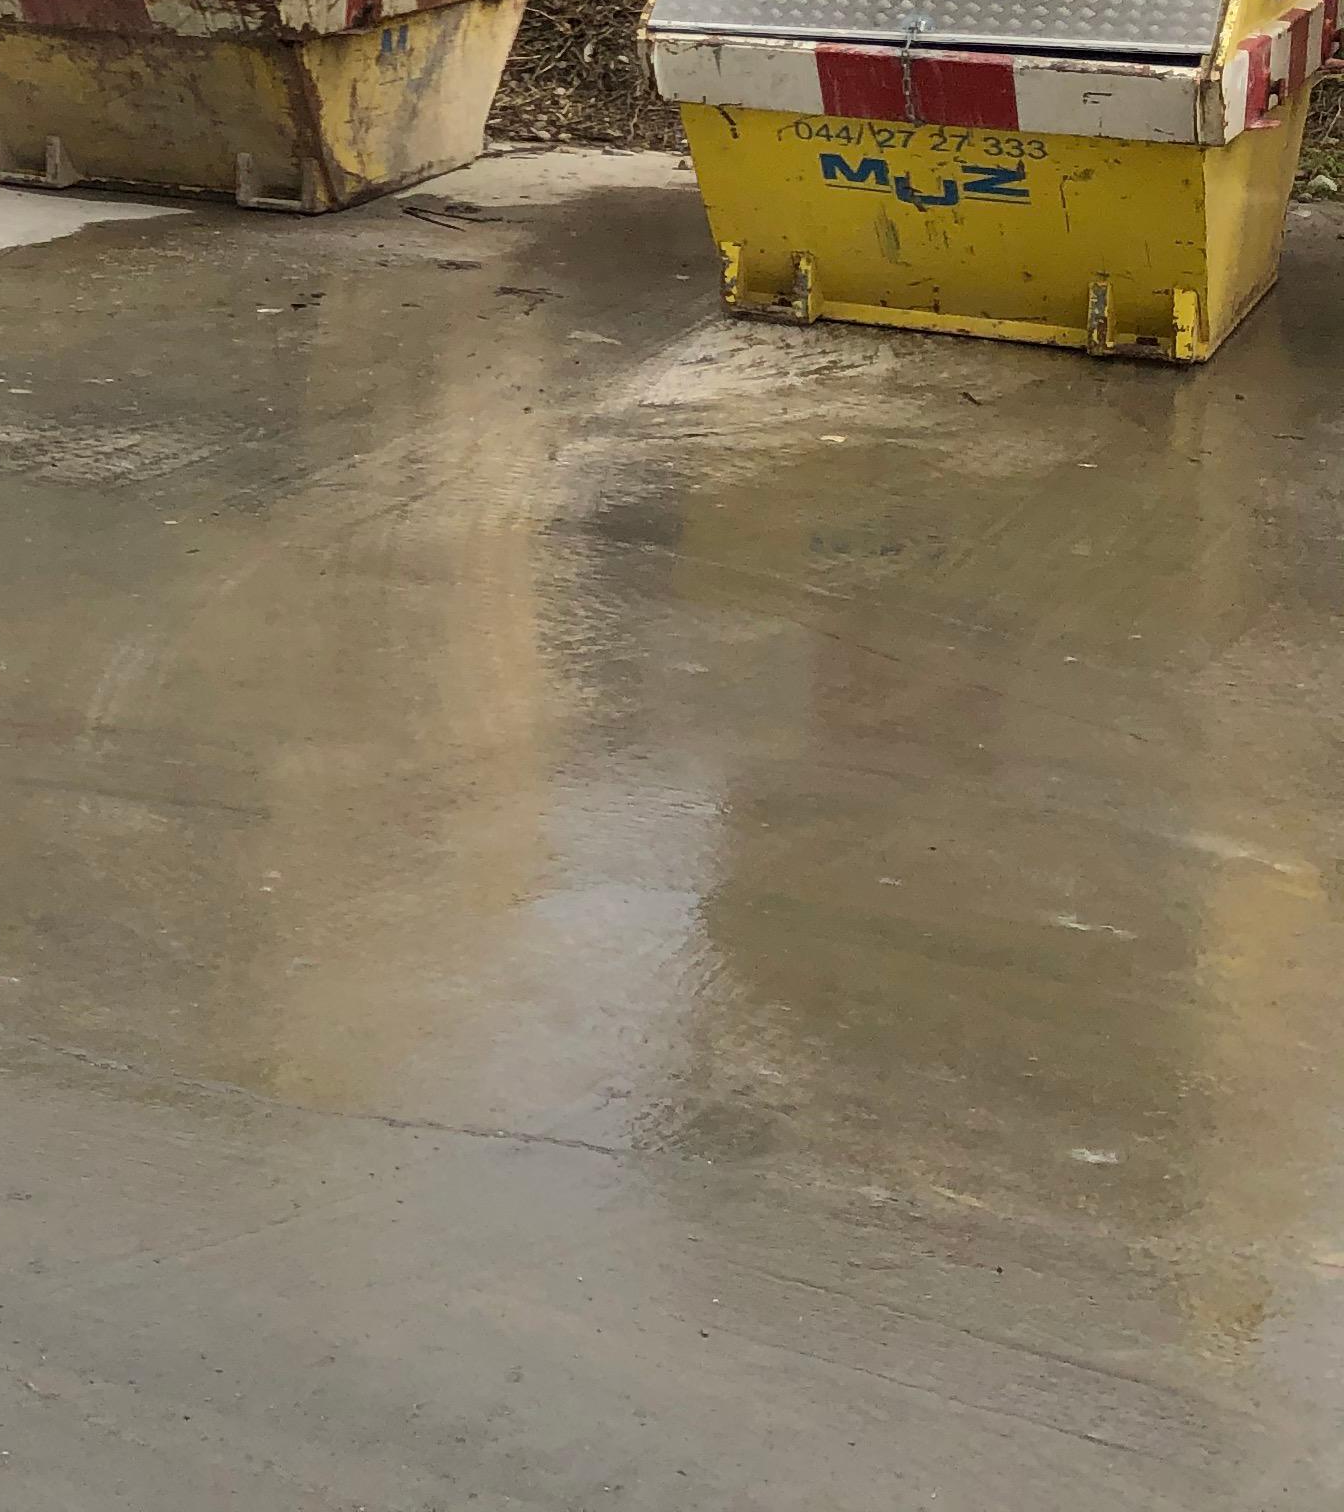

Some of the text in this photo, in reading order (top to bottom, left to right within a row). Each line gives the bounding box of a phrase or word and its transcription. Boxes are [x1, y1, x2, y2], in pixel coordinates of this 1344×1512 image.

[795, 120, 1048, 160] 044/ 27 27 333
[819, 153, 1030, 208] MUZ
